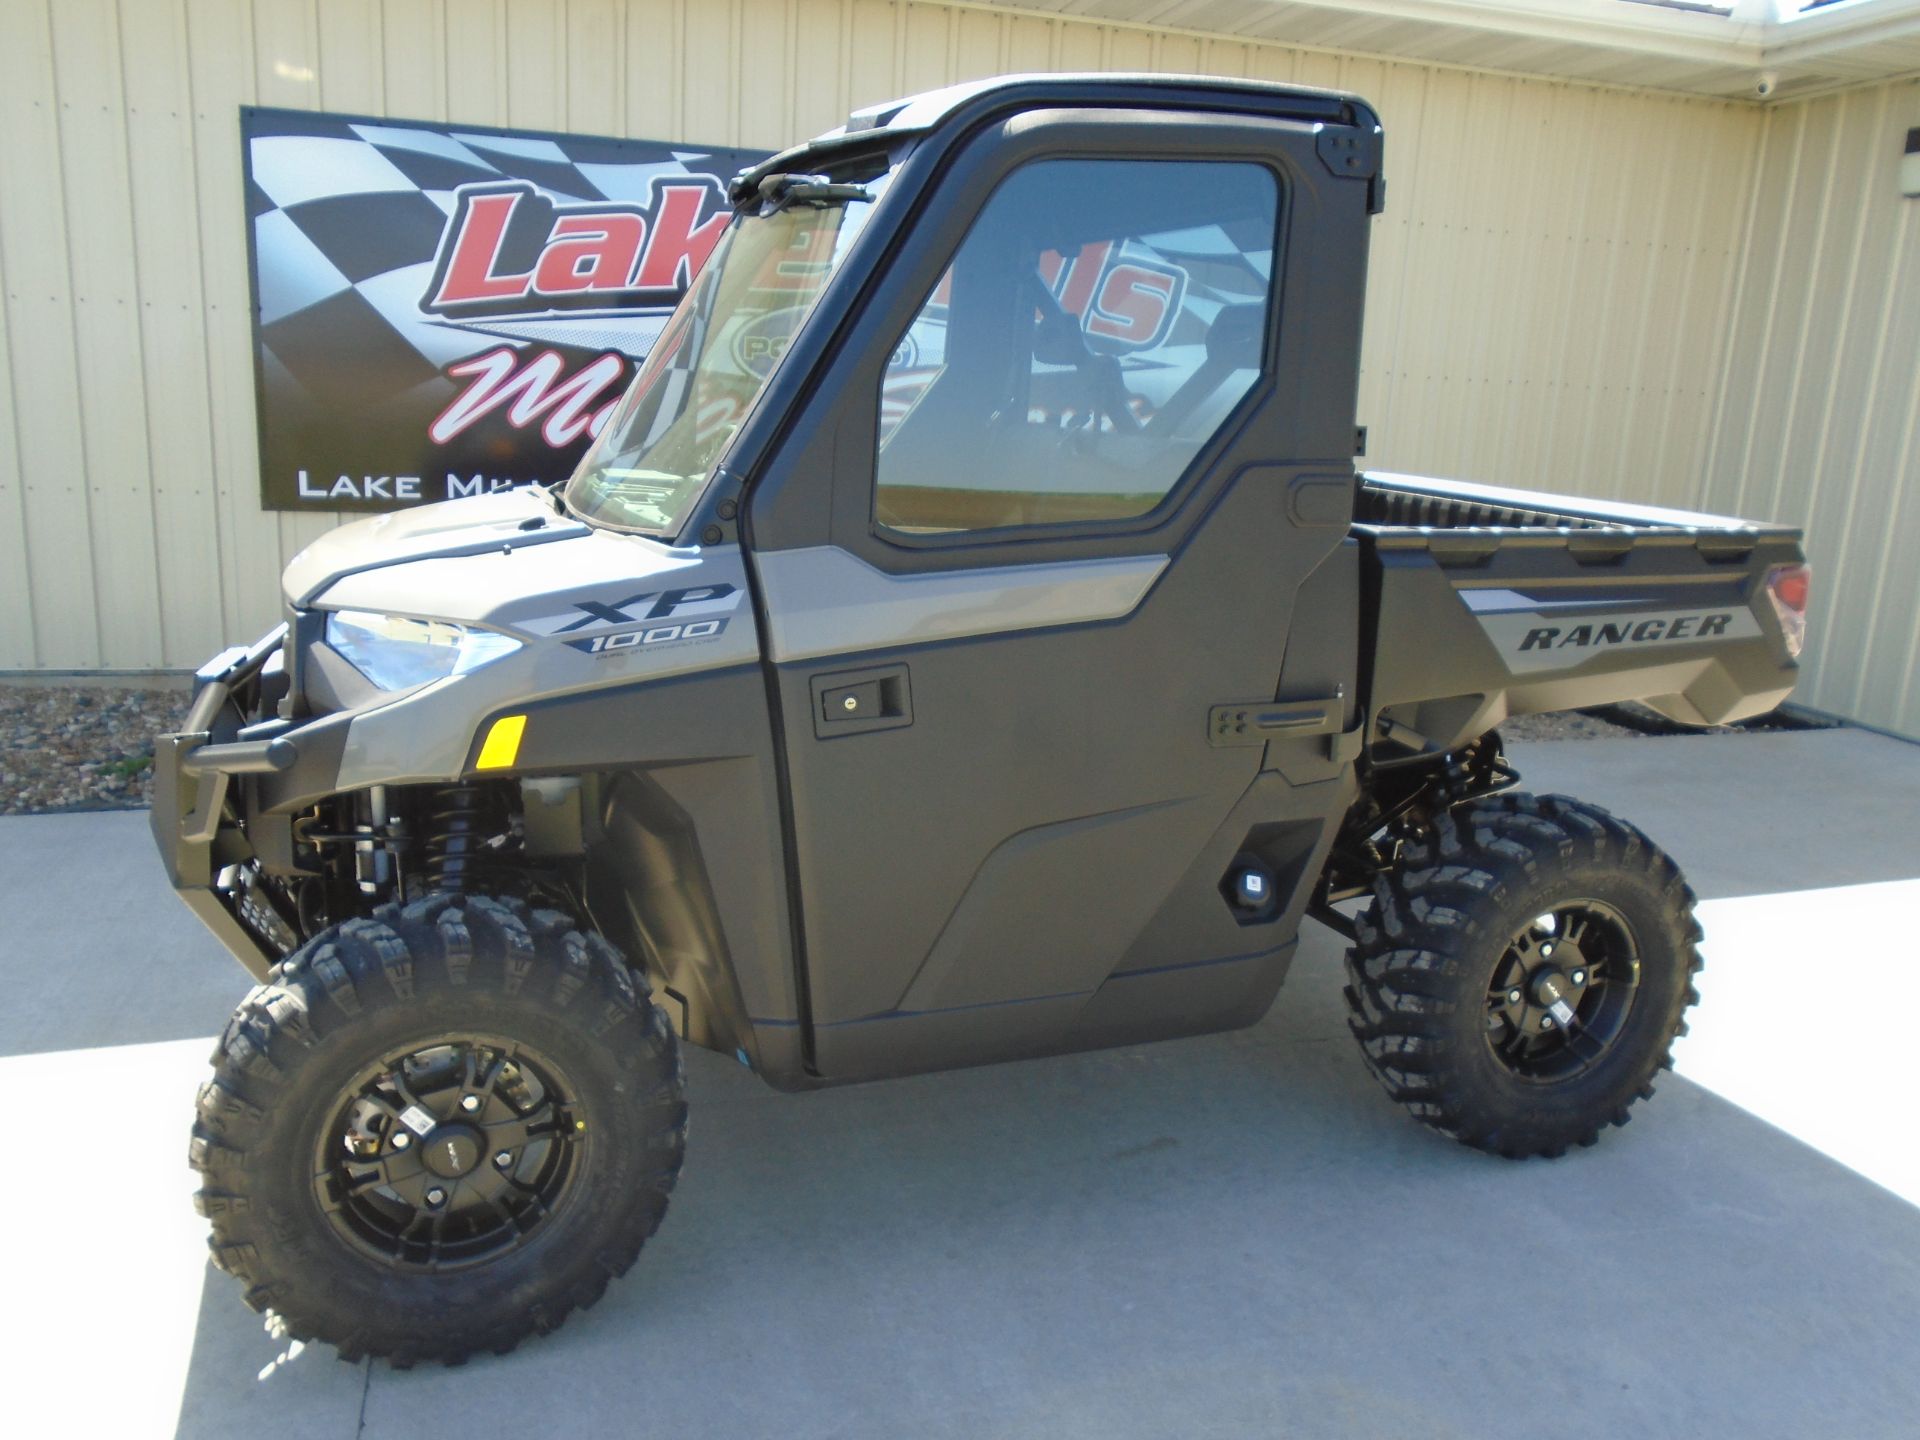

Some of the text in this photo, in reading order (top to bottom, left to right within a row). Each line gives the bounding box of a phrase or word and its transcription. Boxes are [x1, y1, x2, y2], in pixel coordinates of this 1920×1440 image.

[551, 582, 738, 634] XP
[590, 620, 720, 652] 1000
[1517, 613, 1733, 651] RANGER
